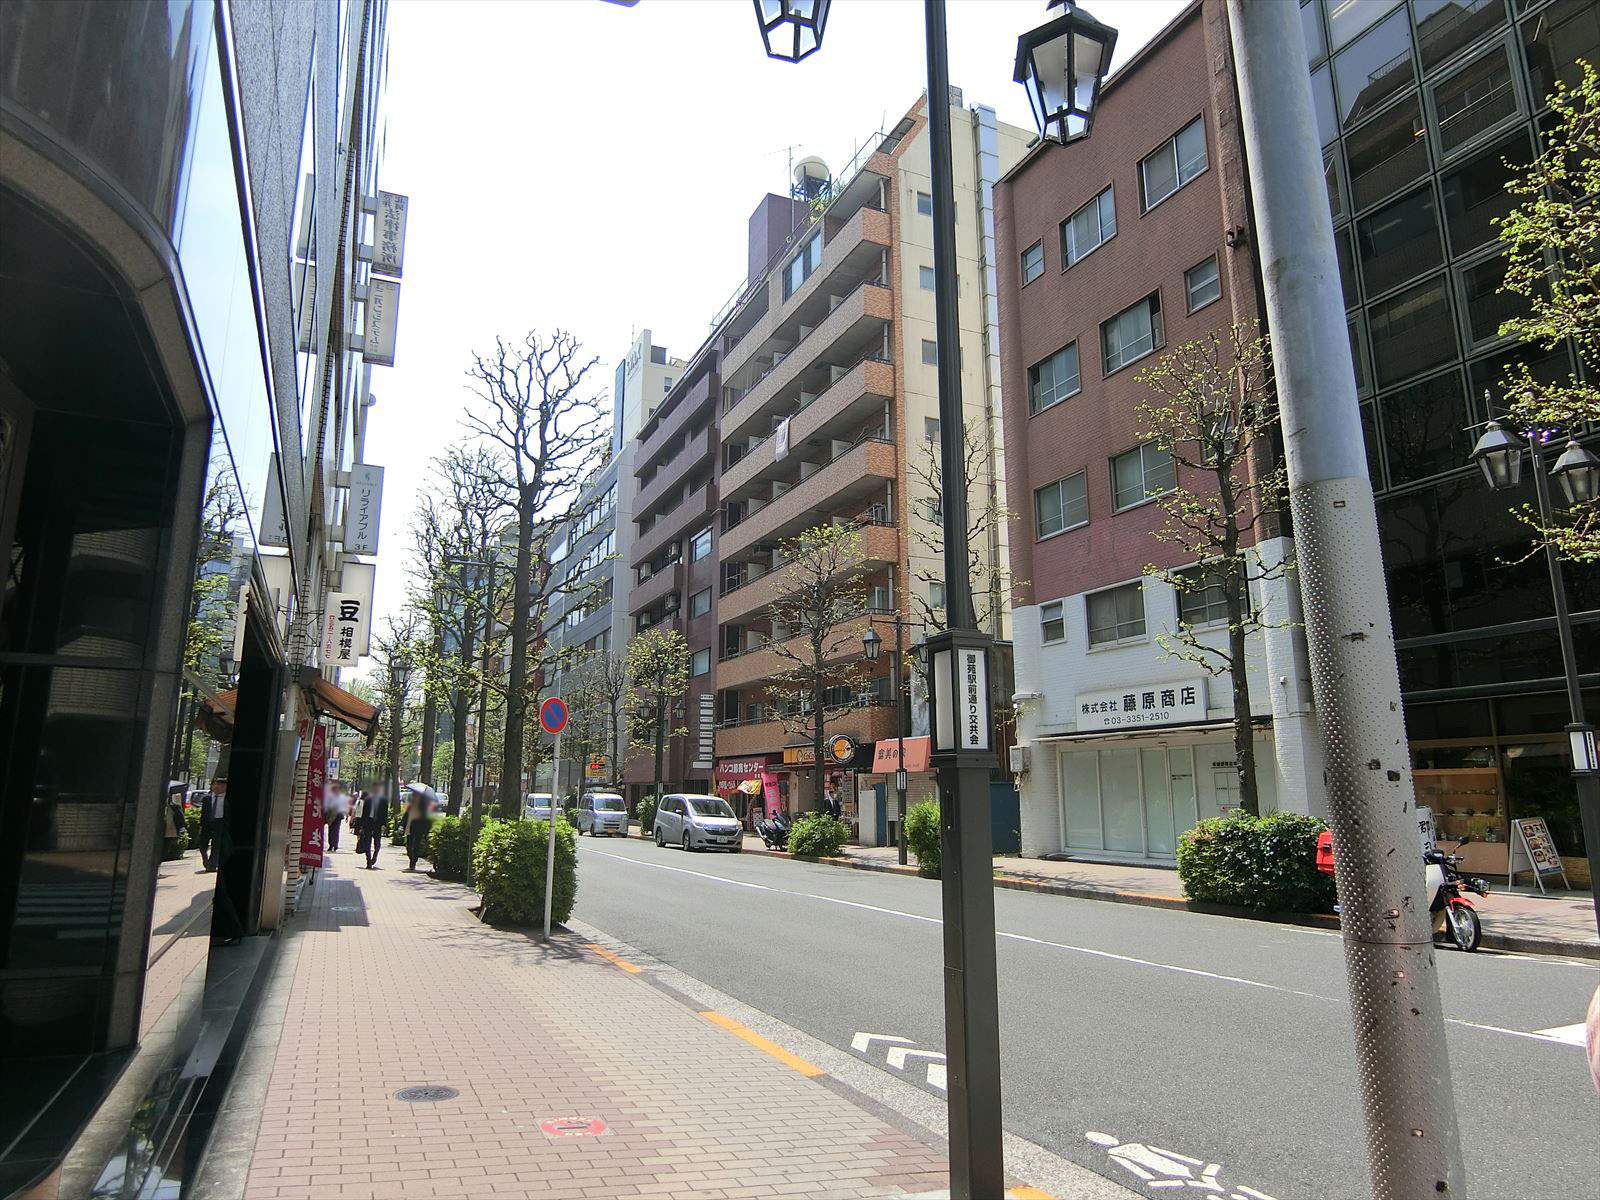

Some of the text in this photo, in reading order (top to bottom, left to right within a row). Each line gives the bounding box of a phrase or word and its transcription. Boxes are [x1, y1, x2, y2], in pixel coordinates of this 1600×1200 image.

[357, 489, 371, 540] リライアブル
[1081, 686, 1196, 715] 株式会社 藤原商店
[1111, 711, 1169, 725] 03-3351-2510
